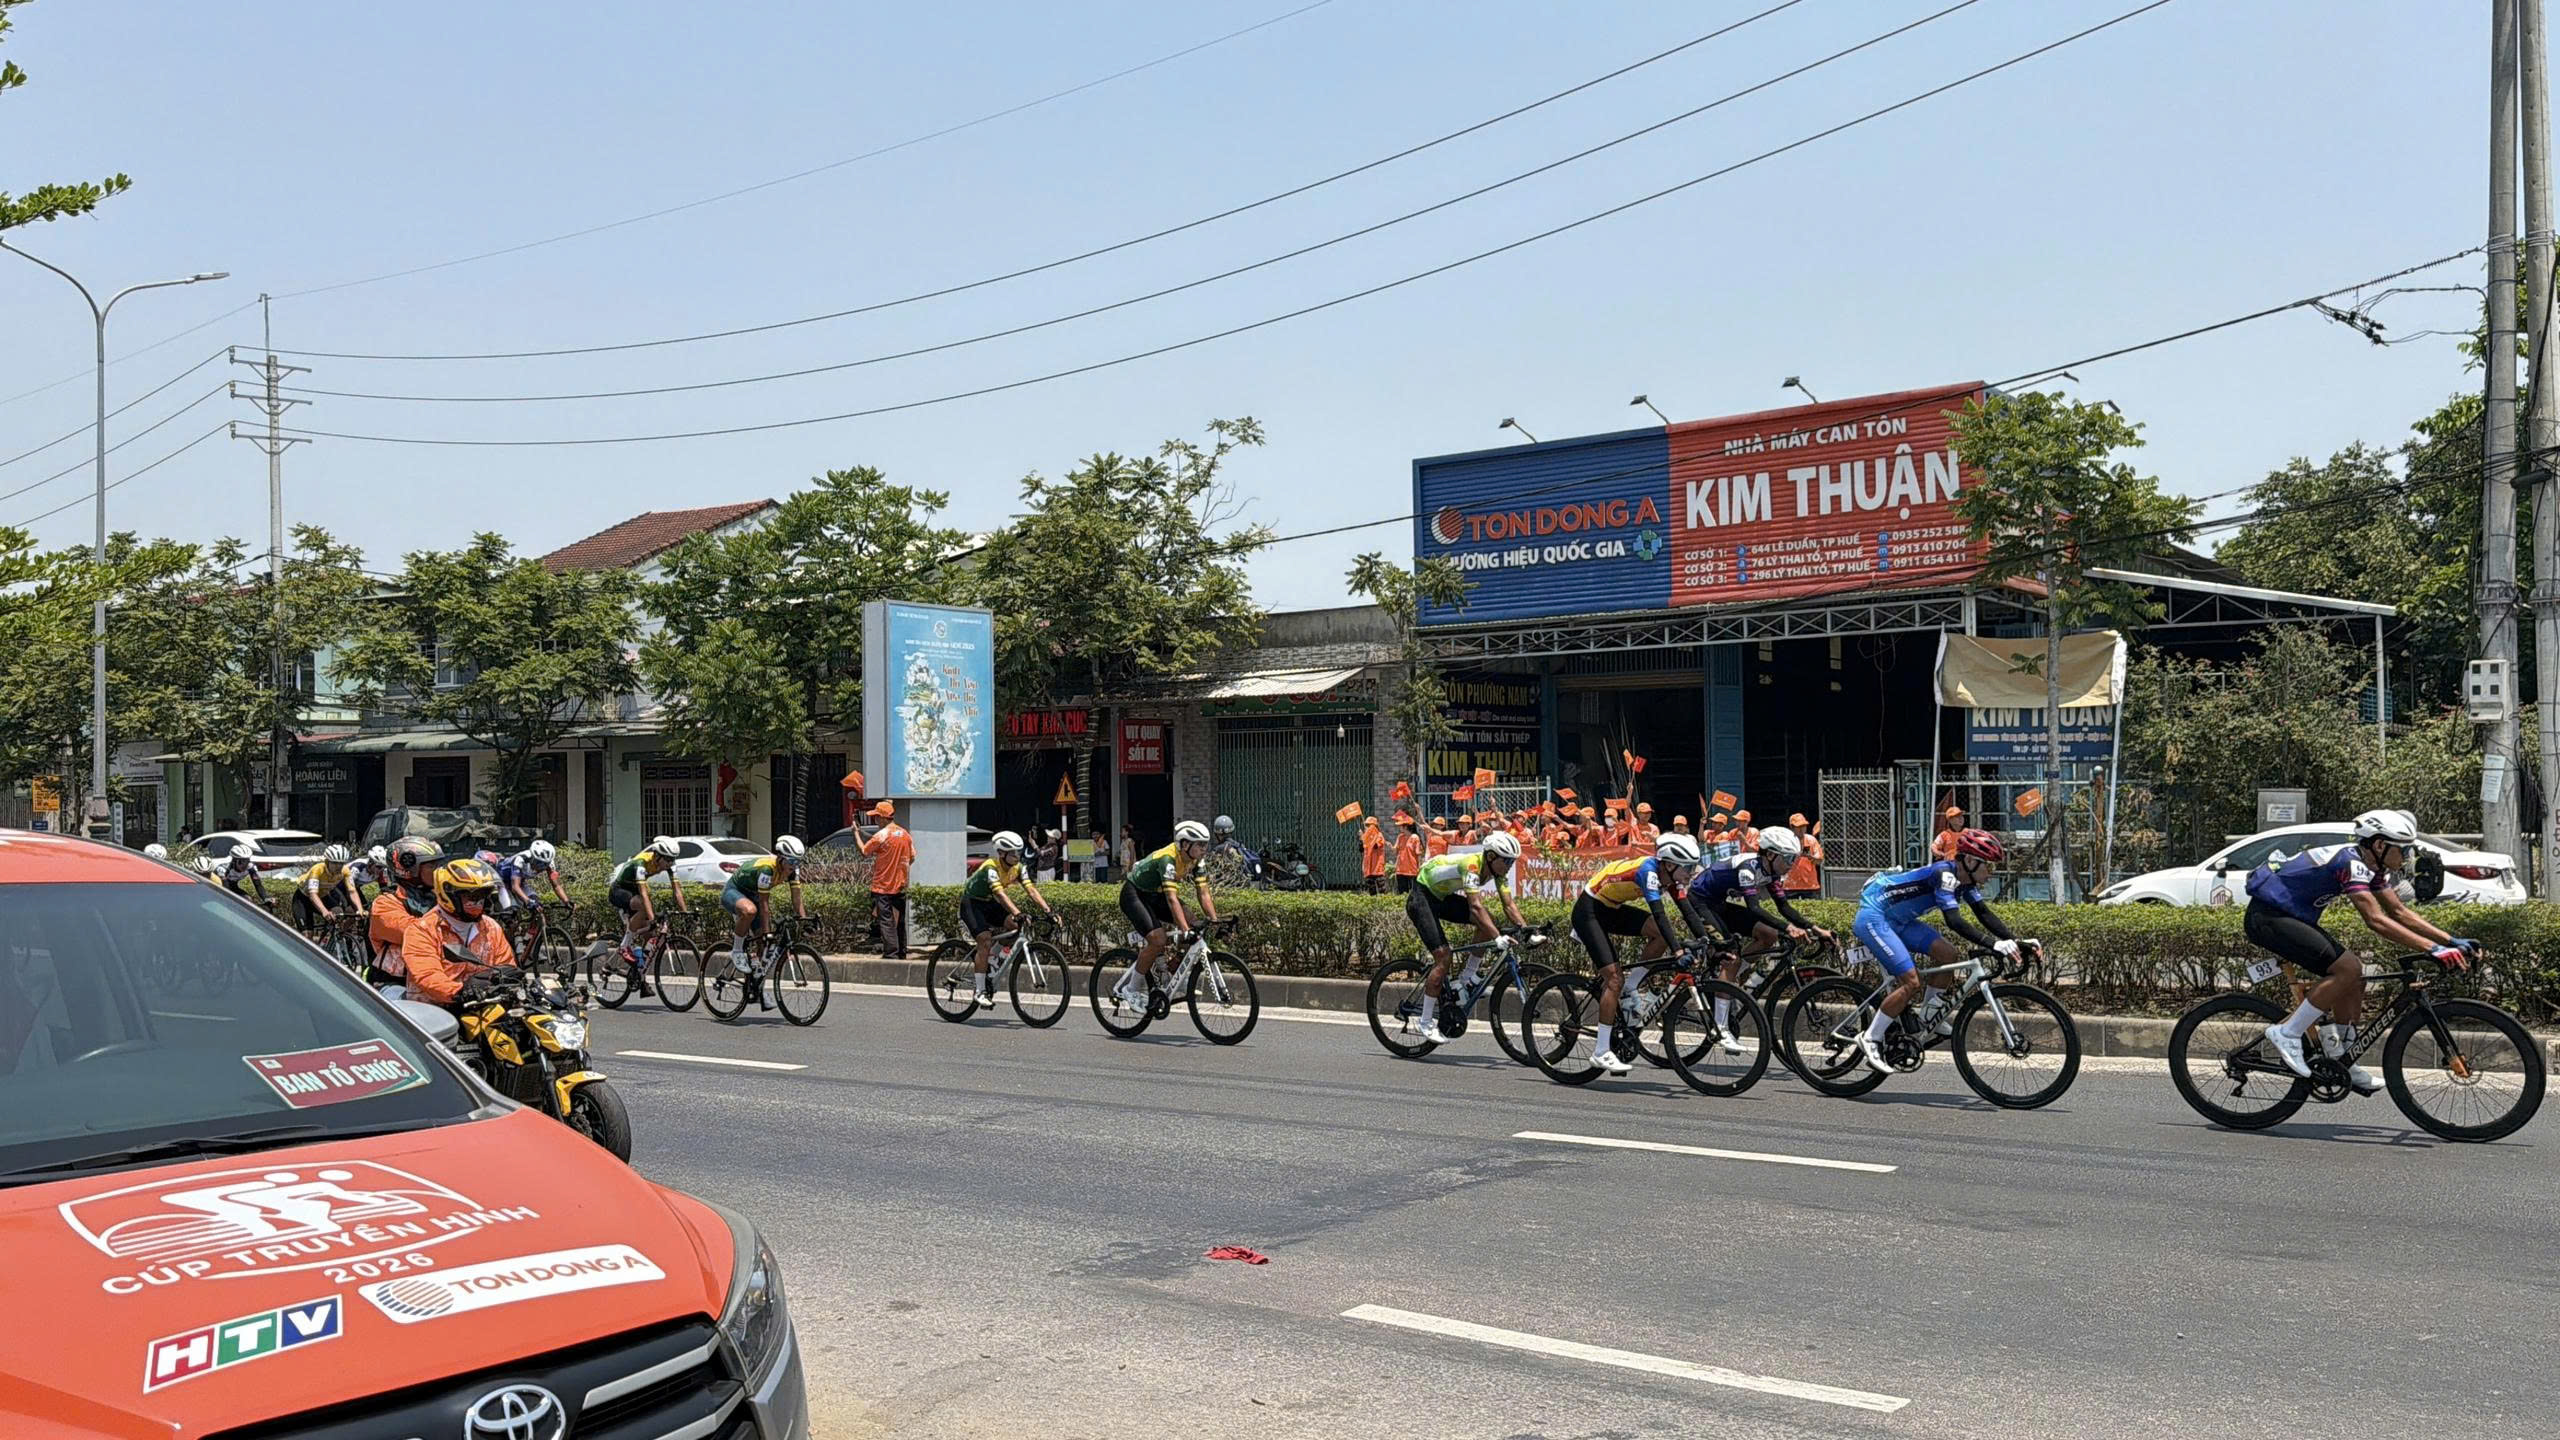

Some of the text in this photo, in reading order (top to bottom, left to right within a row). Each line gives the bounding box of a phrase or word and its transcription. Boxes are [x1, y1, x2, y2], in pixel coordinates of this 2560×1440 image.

[1724, 415, 1907, 457] NHÀ MÁY CAN TÔN
[1686, 443, 1961, 530] KIM THUẬN
[1467, 496, 1660, 541] TON DONG A
[1823, 538, 1834, 547] TP
[1837, 532, 1860, 545] HUẾ
[1892, 530, 1920, 541] 0935
[1504, 546, 1539, 569] HIỆU
[1543, 538, 1591, 564] QUỐC
[1595, 540, 1626, 558] GIA
[1685, 551, 1698, 561] CƠ
[1700, 547, 1714, 559] SỞ
[1825, 551, 1838, 560] TP
[1840, 546, 1863, 559] HUẾ
[1892, 538, 1966, 554] 0913 410 704
[1685, 564, 1698, 574] CƠ
[1700, 561, 1714, 573] SỞ
[1832, 563, 1845, 573] TP
[1893, 553, 1966, 568] 0911 654 411
[1685, 577, 1698, 586] CƠ
[1700, 574, 1714, 585] SỞ
[1428, 751, 1468, 776] KIM
[2255, 961, 2273, 977] 93
[273, 1058, 411, 1095] BAN TỔ CHỨC
[102, 1205, 540, 1295] CÚP TRUYỀN HÌNH
[323, 1252, 436, 1285] 2026
[447, 1255, 649, 1294] TON DONG A
[154, 1303, 332, 1379] HTV
